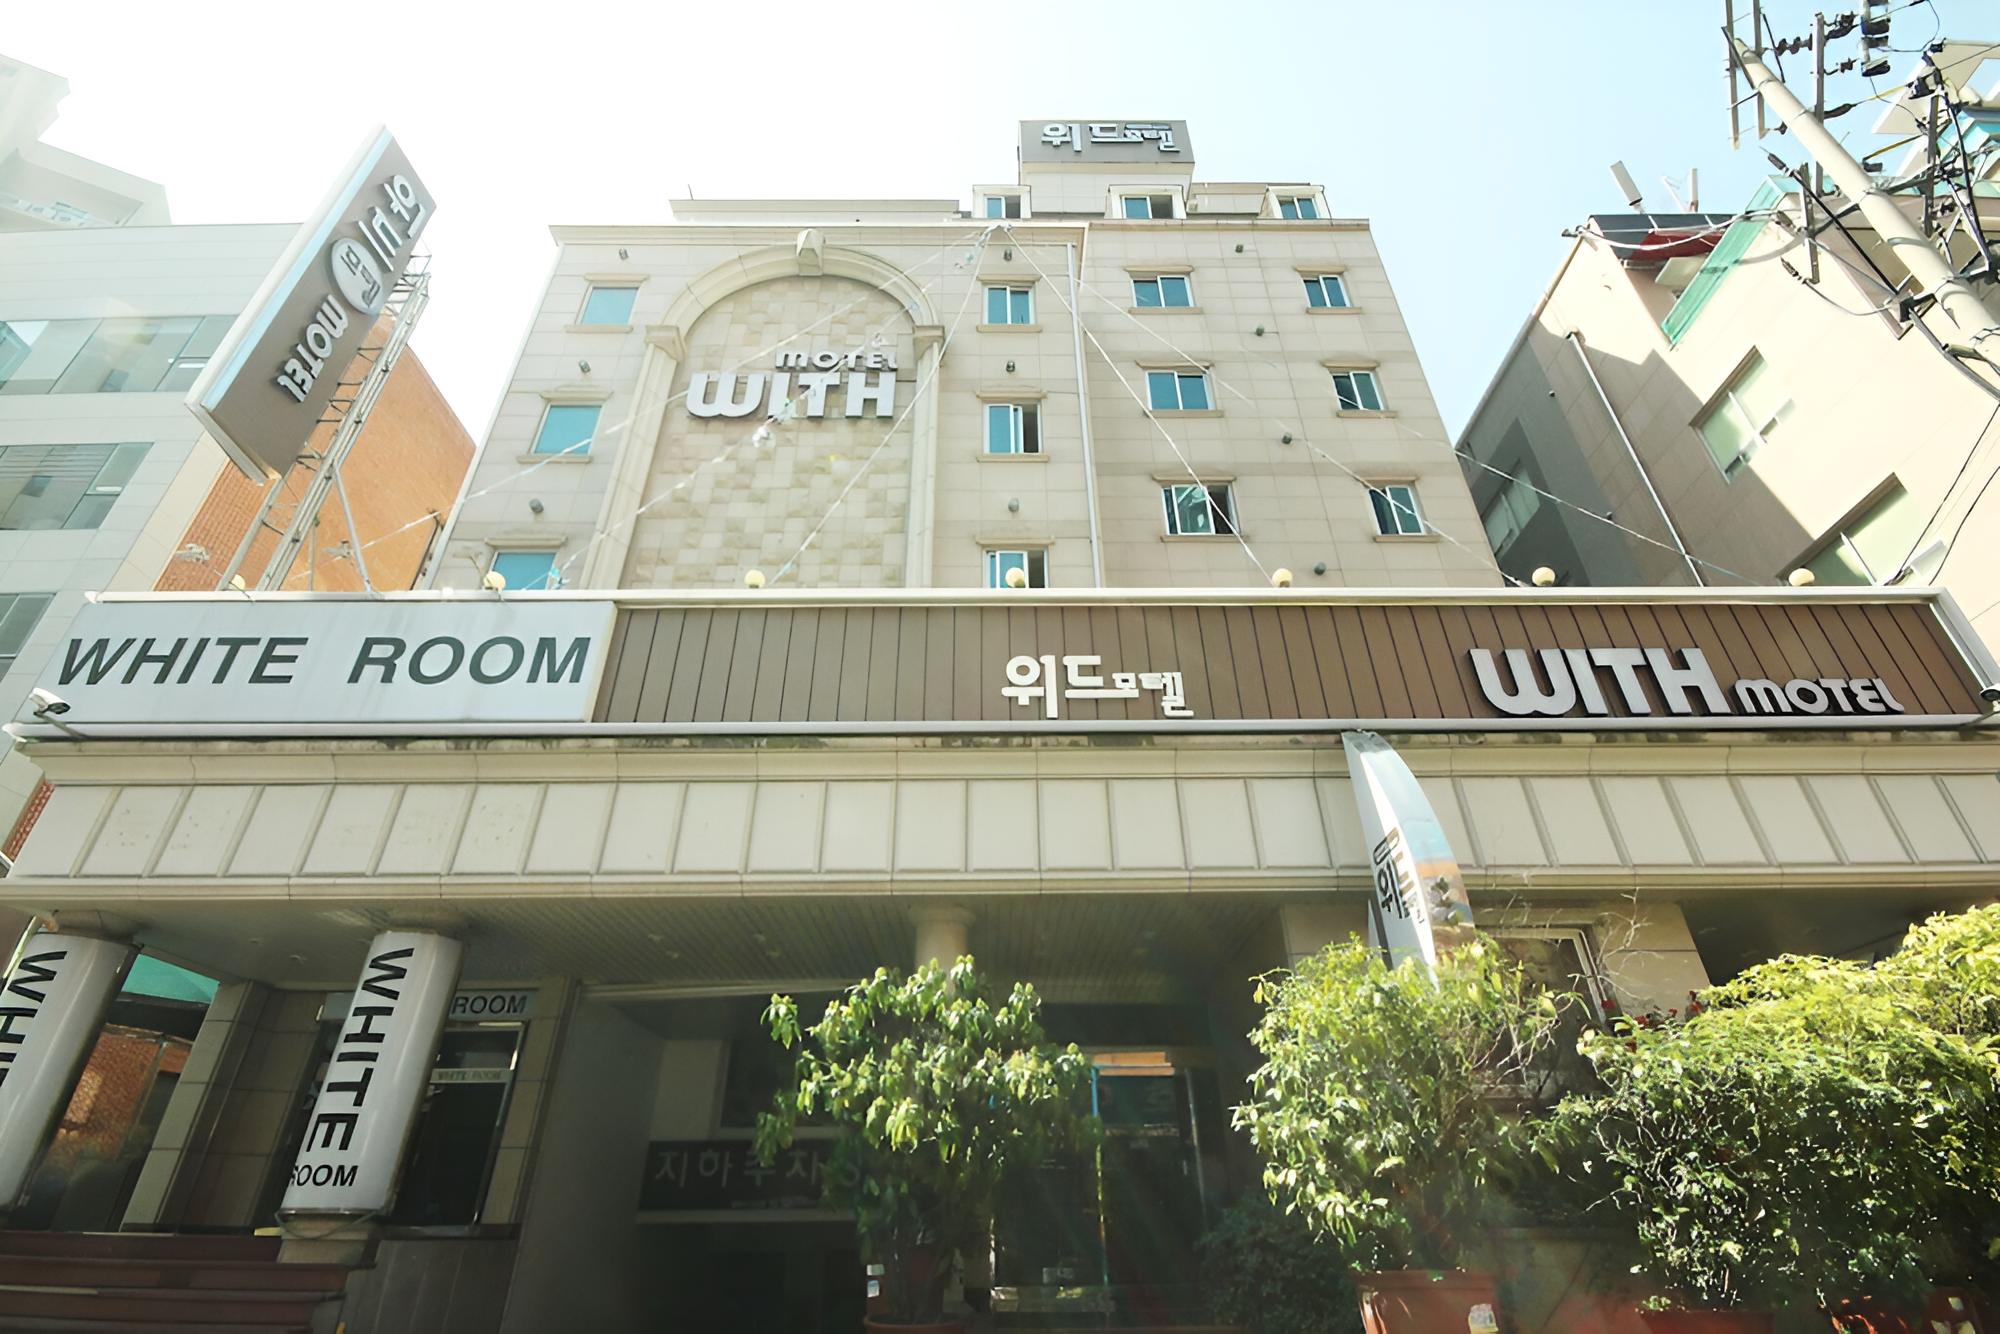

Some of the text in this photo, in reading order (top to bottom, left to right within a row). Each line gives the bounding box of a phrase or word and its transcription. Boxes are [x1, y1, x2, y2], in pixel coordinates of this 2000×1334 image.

[686, 372, 898, 418] WITH
[57, 636, 591, 686] WHITE ROOM
[1002, 655, 1194, 719] 위드모텔
[1468, 647, 1732, 716] WITH
[451, 994, 528, 1015] ROOM
[305, 947, 415, 1153] WHITE
